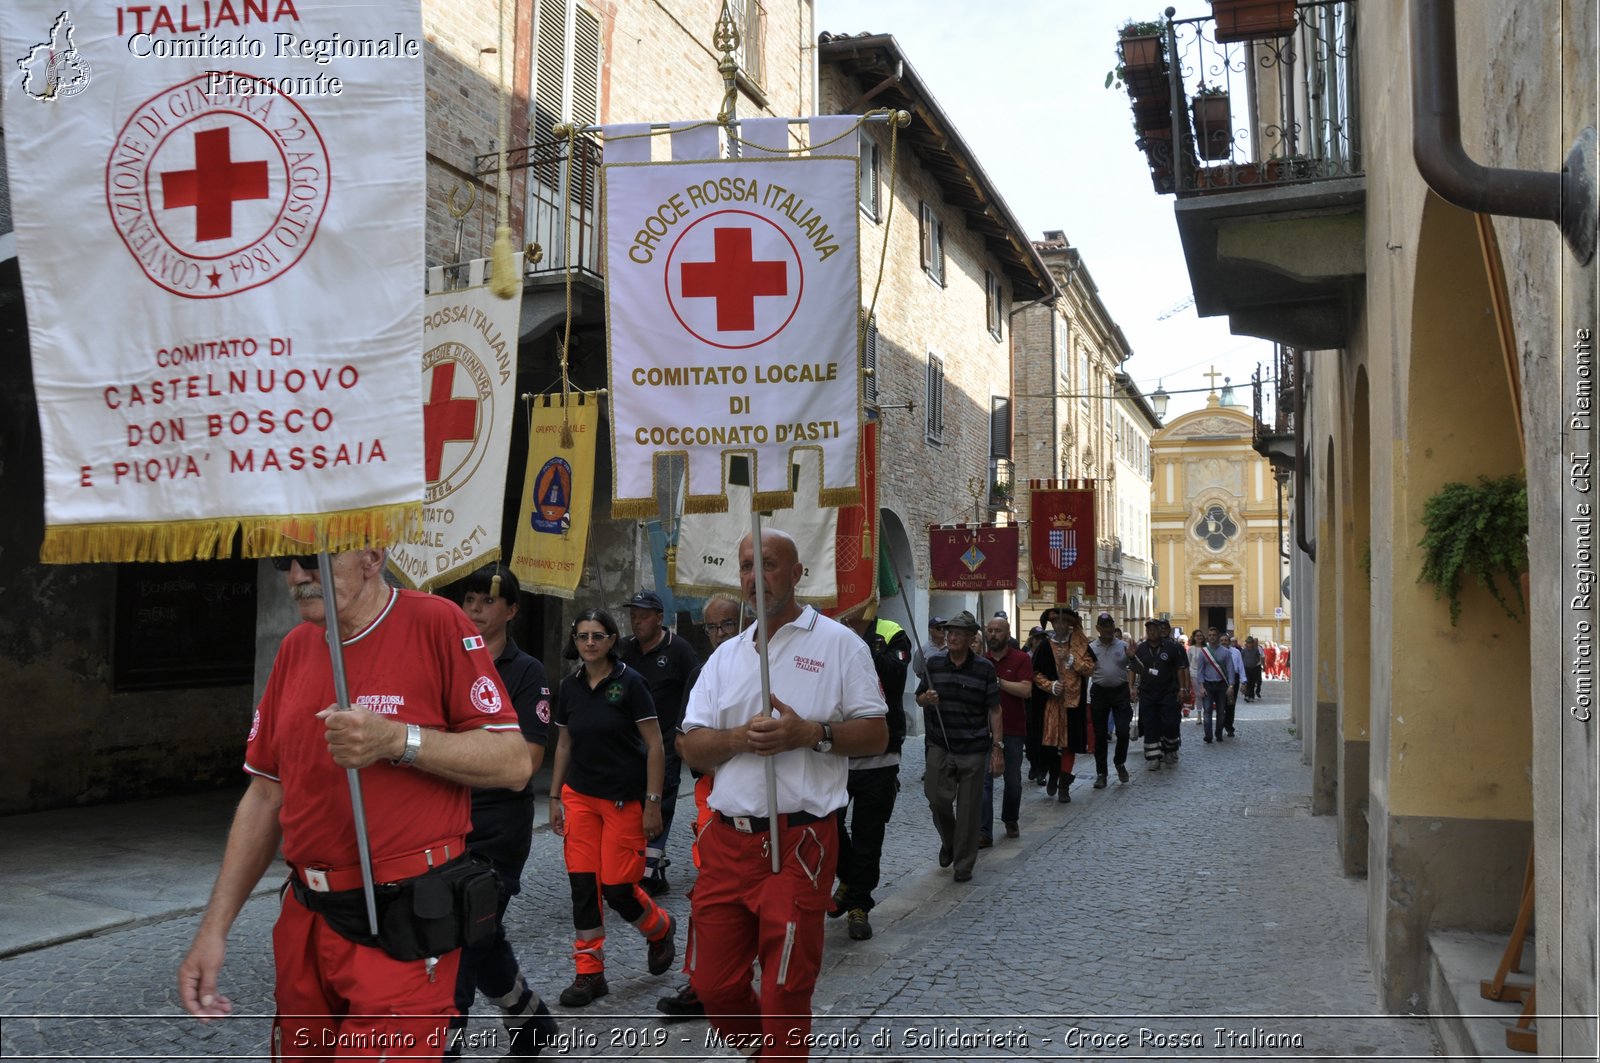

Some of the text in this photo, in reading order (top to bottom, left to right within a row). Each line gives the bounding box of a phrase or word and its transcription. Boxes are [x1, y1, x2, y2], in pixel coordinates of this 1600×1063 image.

[117, 0, 300, 36] ITALIANA
[136, 106, 168, 139] DI
[273, 117, 306, 148] 22
[113, 136, 200, 289] CONVENZIONE
[274, 151, 320, 248] AGOSTO
[628, 176, 840, 264] CROCE ROSSA ITALIANA
[229, 243, 281, 283] 1864
[156, 337, 292, 368] COMITATO DI
[424, 304, 511, 386] ROSSA ITALIANA
[104, 365, 360, 411] CASTELNUOVO
[631, 362, 838, 386] COMITATO LOCALE
[729, 395, 751, 415] DI
[127, 406, 334, 448] DON BOSCO
[635, 421, 840, 446] COCCONATO D'ASTI
[79, 438, 388, 488] E PIOVA' MASSAIA
[435, 523, 488, 574] D'ASTI
[948, 534, 1000, 545] A.VI.S.
[516, 555, 528, 566] SAN
[702, 555, 725, 567] 1947
[380, 695, 404, 705] ROSSA
